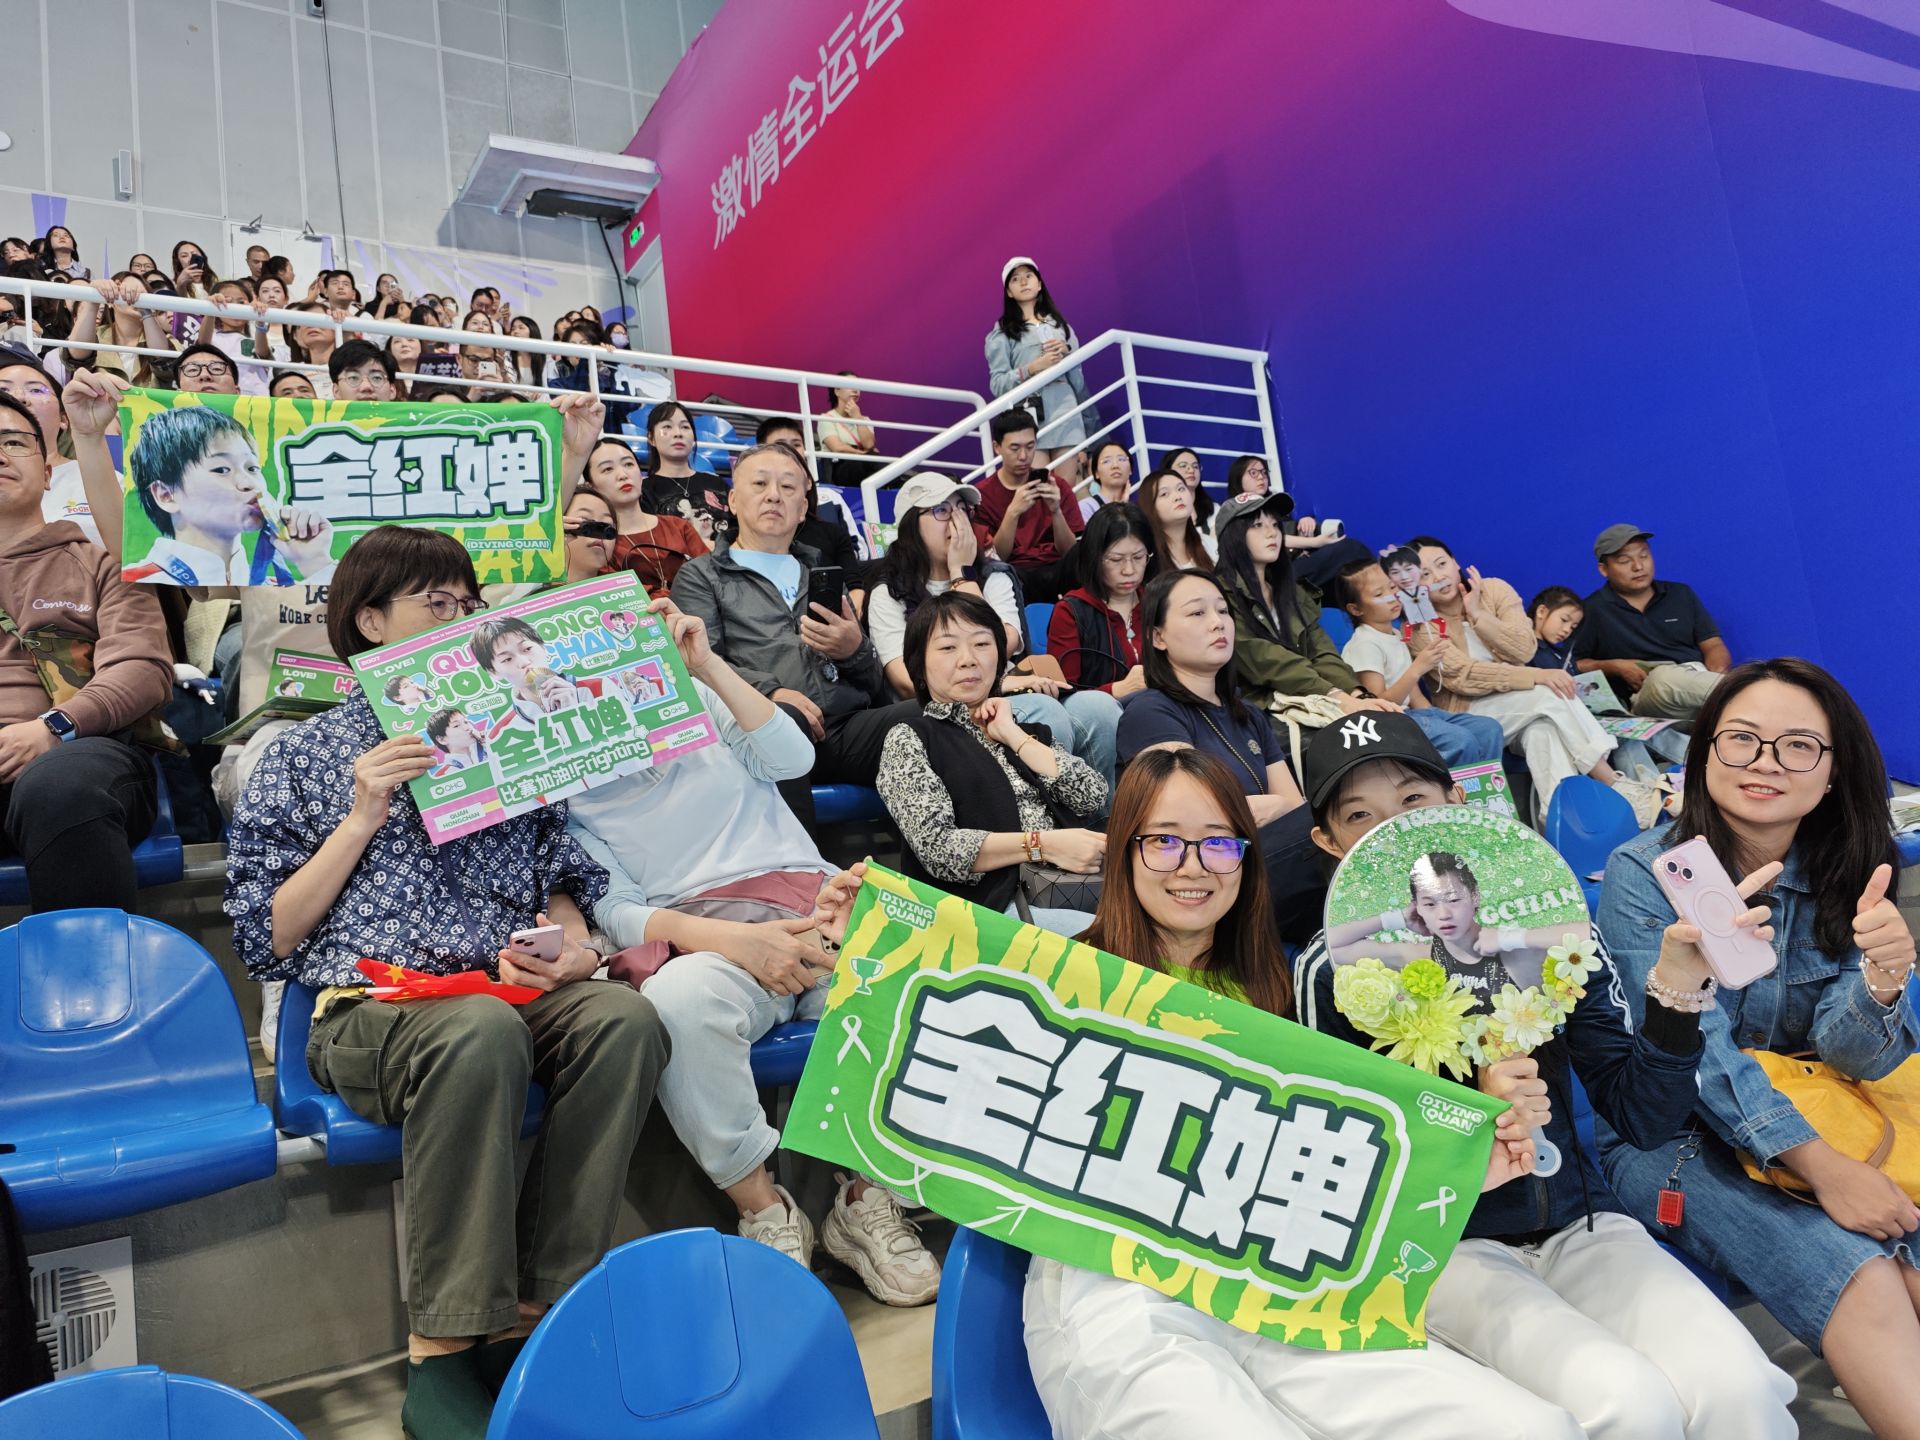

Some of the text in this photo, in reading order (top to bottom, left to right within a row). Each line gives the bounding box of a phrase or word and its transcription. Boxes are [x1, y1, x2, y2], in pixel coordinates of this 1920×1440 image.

[711, 0, 904, 250] 激情全运会
[288, 430, 545, 520] 全红婵
[32, 598, 92, 612] Converse
[489, 695, 632, 779] 全红婵
[881, 891, 934, 920] DIVING
[886, 904, 927, 928] QUAN
[1421, 1095, 1483, 1123] DIVING
[1426, 1108, 1474, 1132] QUAN
[888, 988, 1382, 1274] 全红婵
